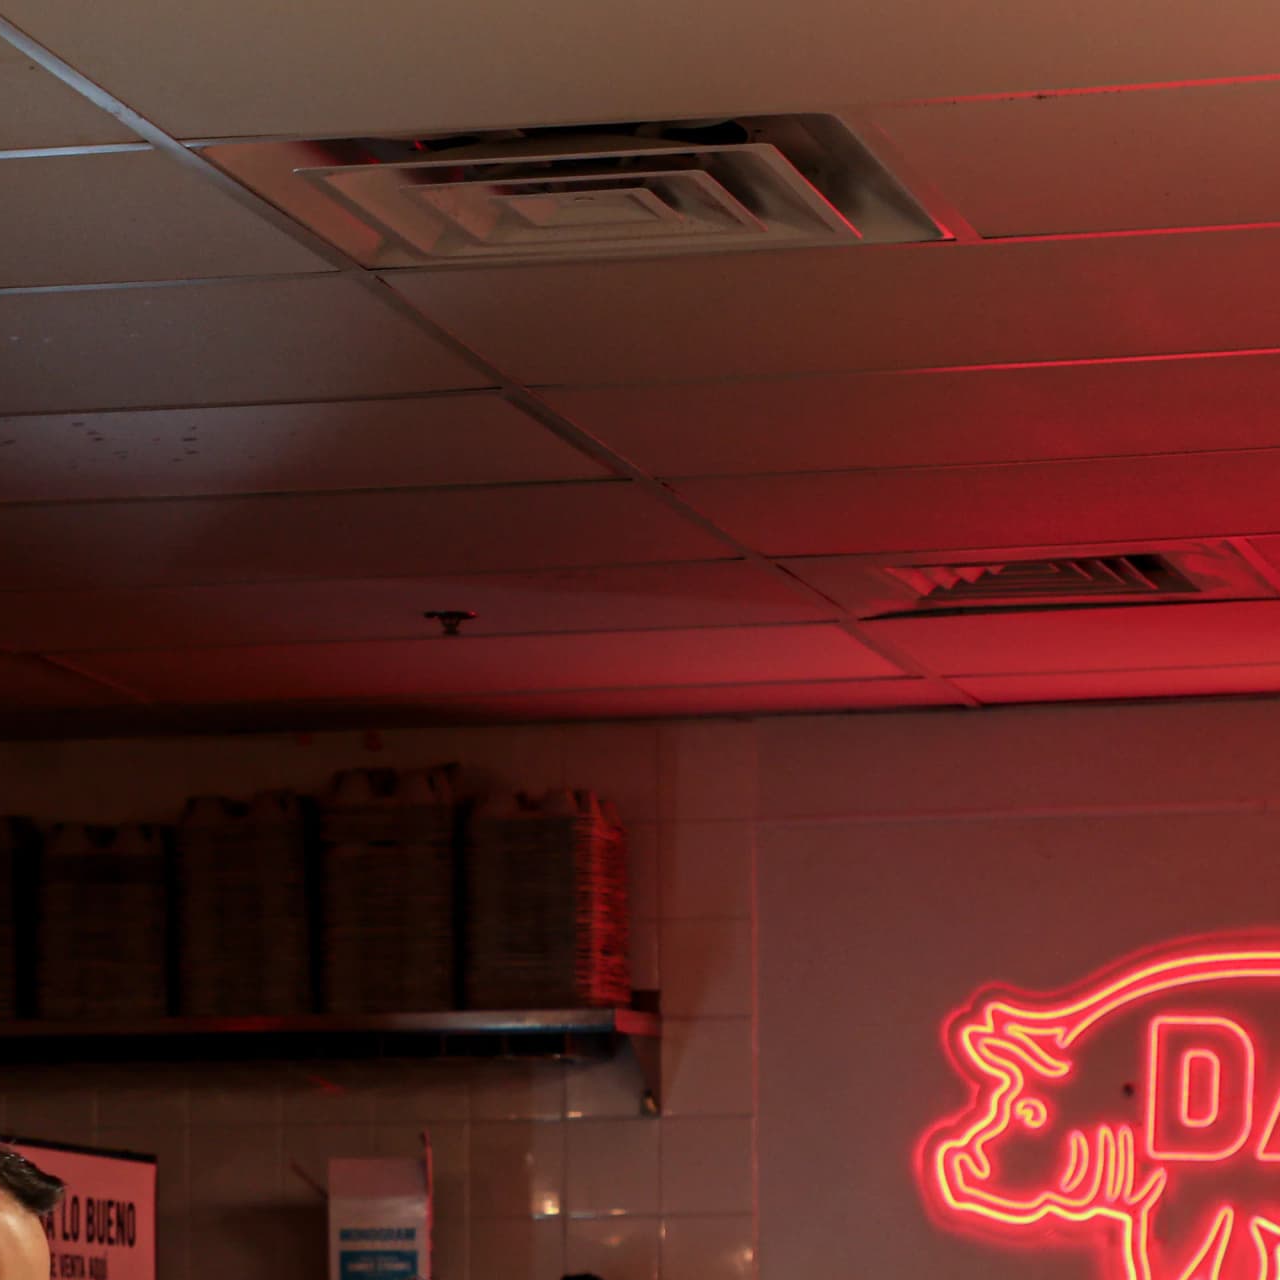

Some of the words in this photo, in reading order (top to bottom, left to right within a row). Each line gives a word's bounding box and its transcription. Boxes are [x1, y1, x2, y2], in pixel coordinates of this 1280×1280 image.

[62, 1195, 80, 1242] LO
[86, 1197, 137, 1248] BUENO
[60, 1254, 86, 1279] VENTA
